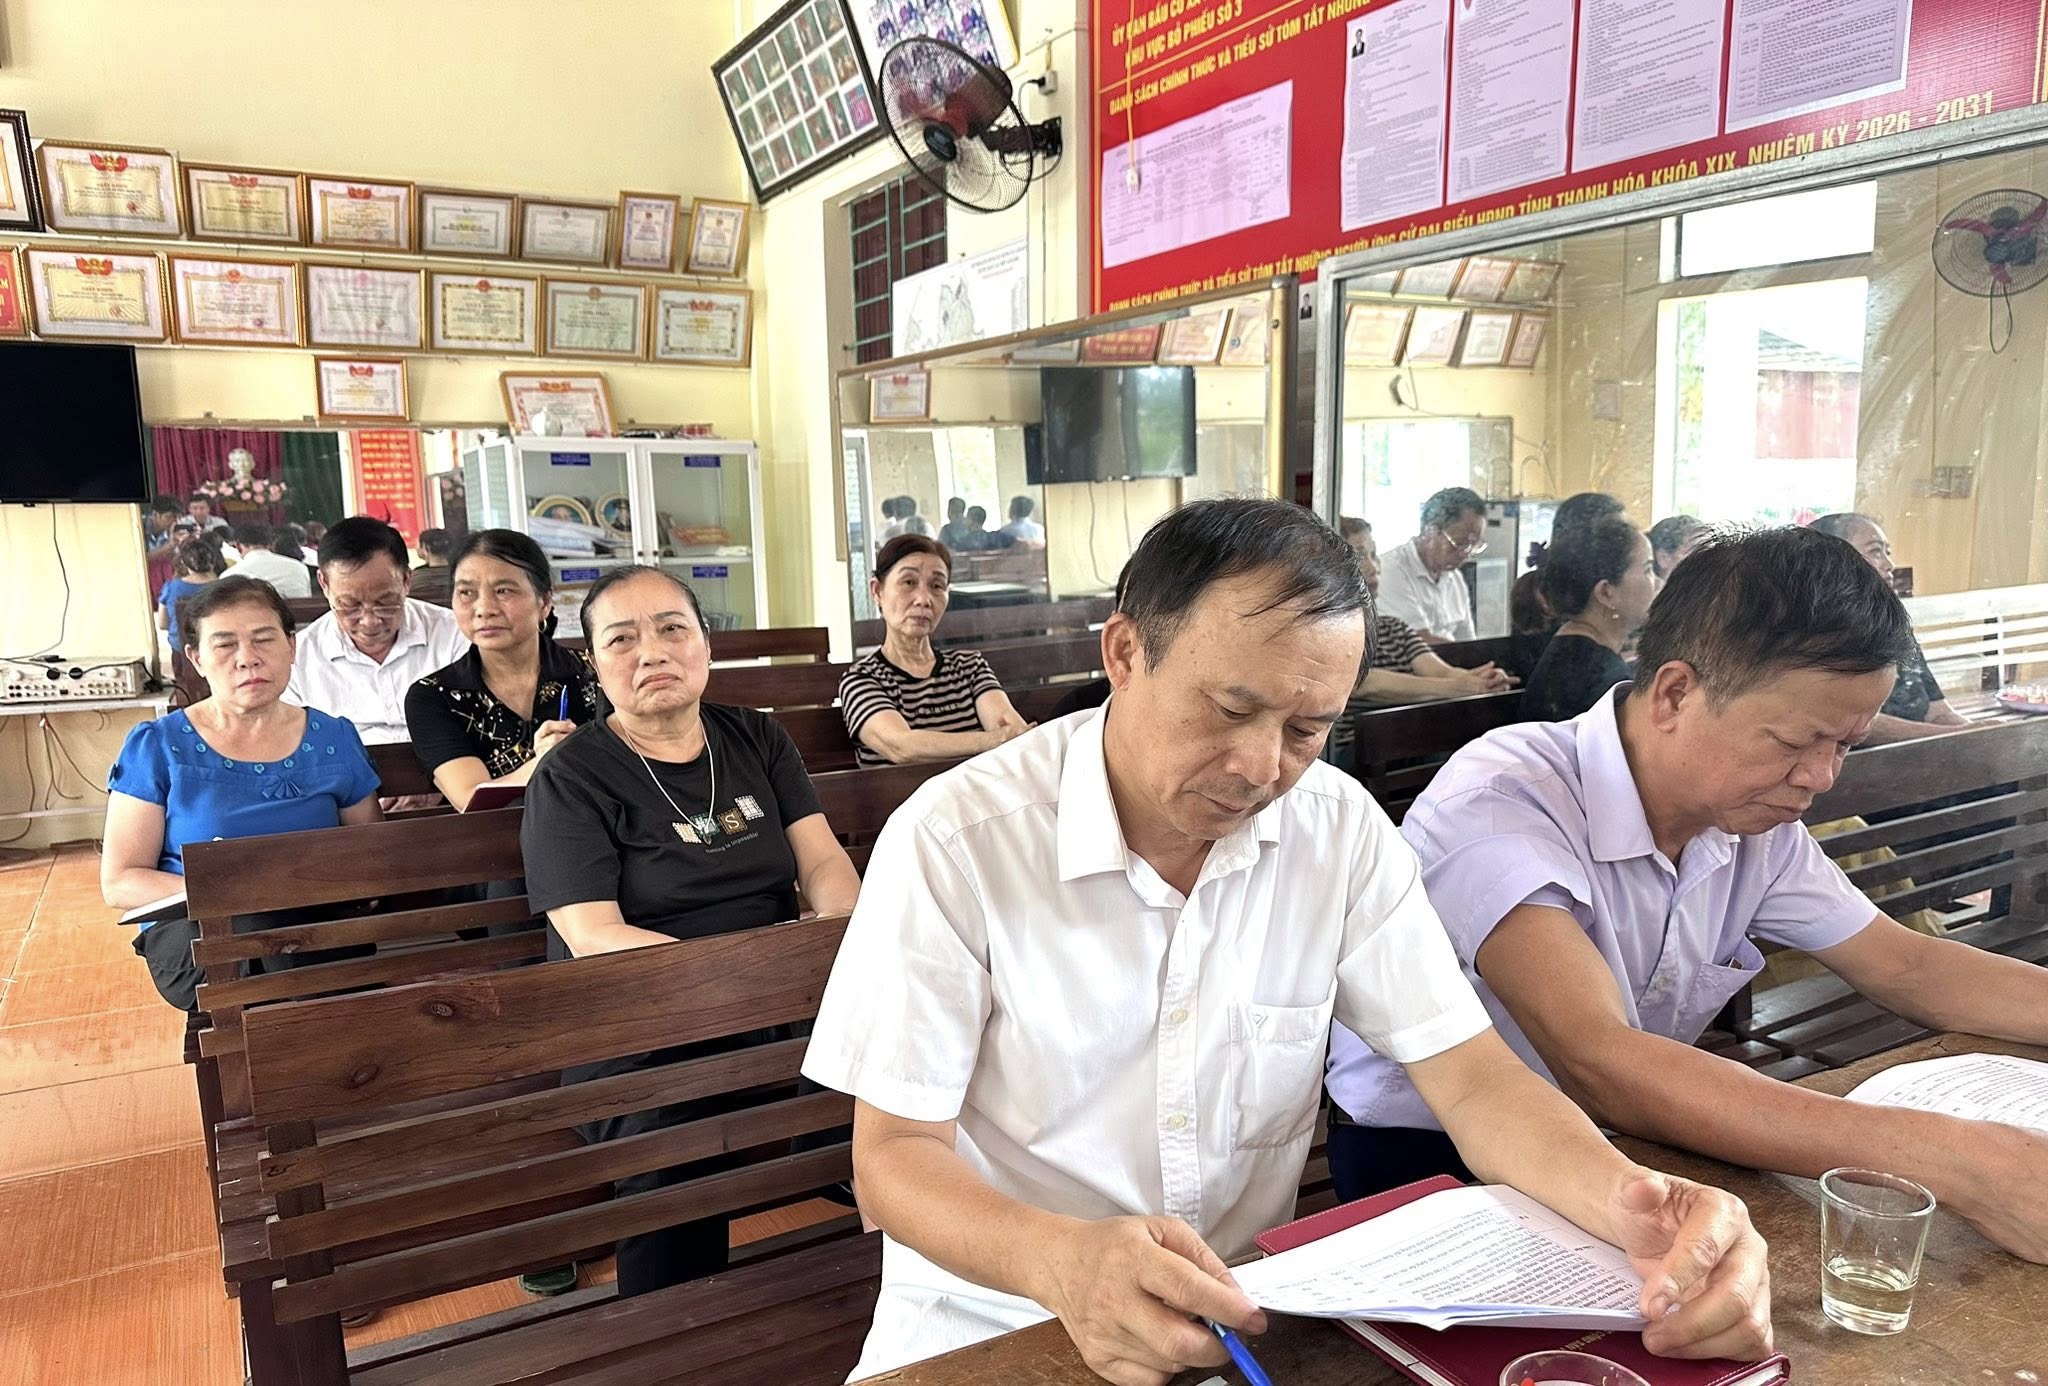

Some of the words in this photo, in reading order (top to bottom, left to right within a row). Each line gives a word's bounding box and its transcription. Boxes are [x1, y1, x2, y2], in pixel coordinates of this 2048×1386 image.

[1134, 79, 1159, 104] SÁCH
[1160, 65, 1190, 94] CHÍNH
[1190, 55, 1217, 81] THỨC
[1217, 44, 1232, 68] VÀ
[1233, 33, 1257, 62] TIỂU
[1258, 23, 1275, 51] SỬ
[1276, 17, 1301, 43] TÓM
[1303, 2, 1326, 31] TẮT
[1183, 6, 1215, 42] PHIẾU
[1234, 0, 1243, 17] 3
[1275, 252, 1294, 275] TẮT
[1556, 181, 1608, 208] THANH
[1612, 171, 1645, 194] HÓA
[1650, 157, 1699, 189] KHÓA
[1854, 108, 1911, 142] 2026
[1934, 90, 1993, 126] 2031
